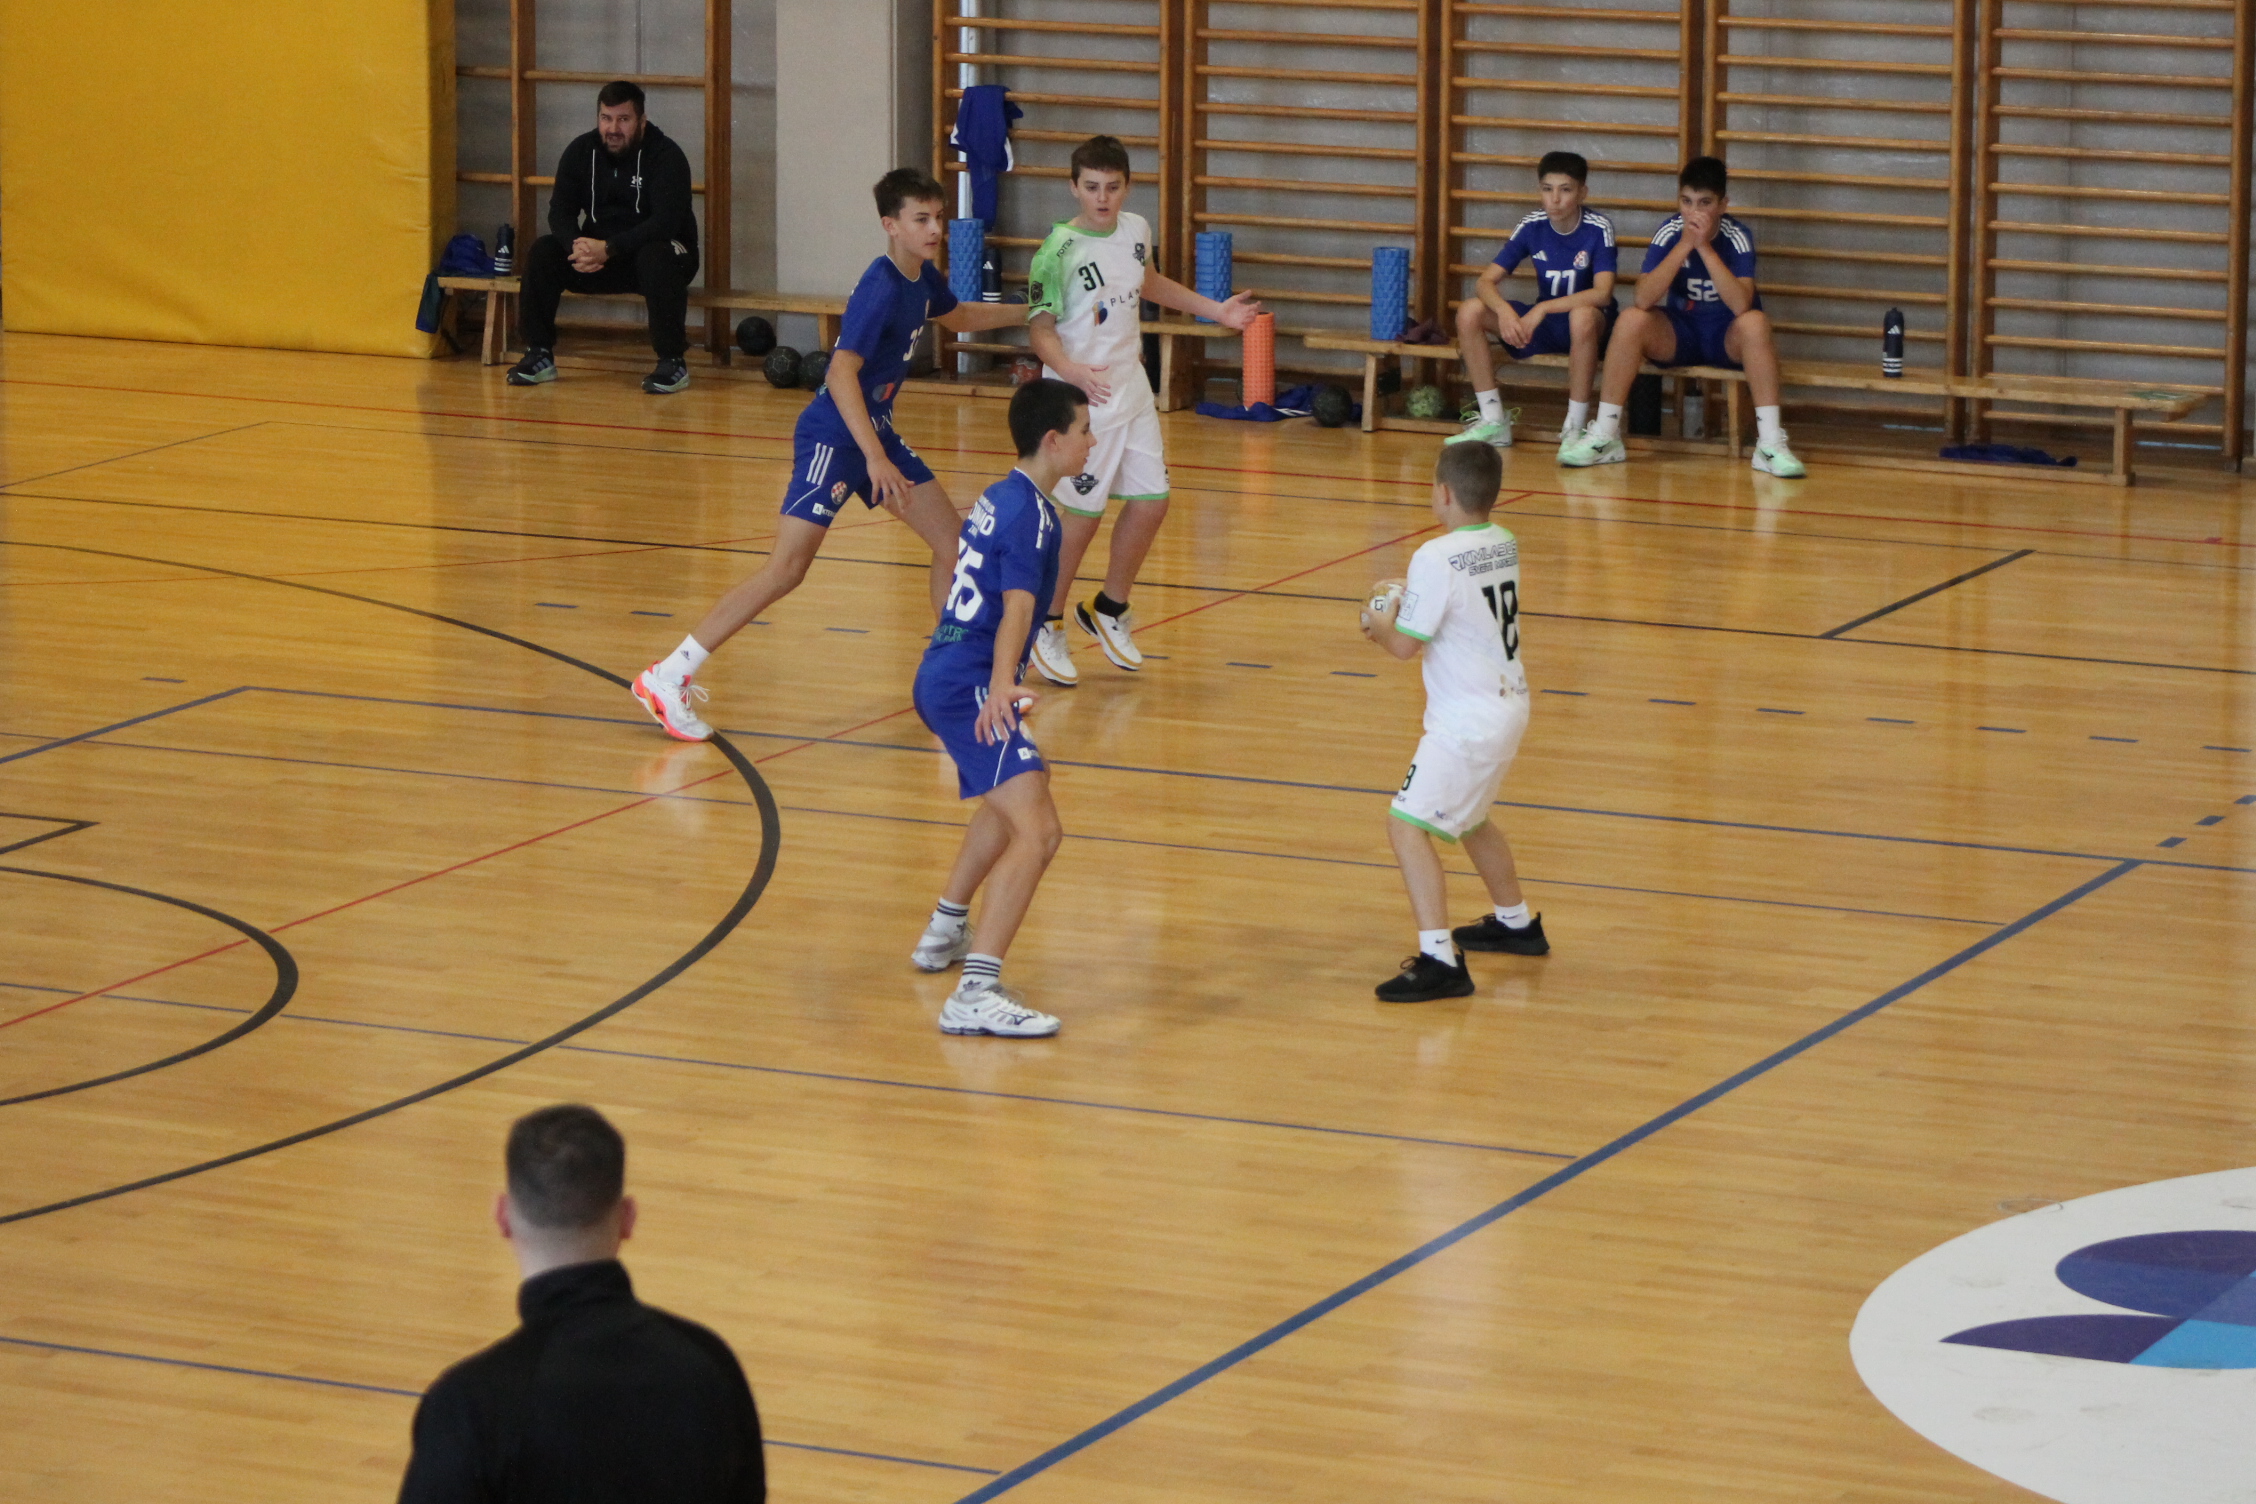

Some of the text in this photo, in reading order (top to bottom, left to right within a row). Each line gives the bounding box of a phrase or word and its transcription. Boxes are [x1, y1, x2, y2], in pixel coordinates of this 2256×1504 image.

[1078, 262, 1105, 292] 31
[1545, 269, 1576, 296] 77
[1687, 278, 1719, 302] 52
[1481, 580, 1519, 662] 18
